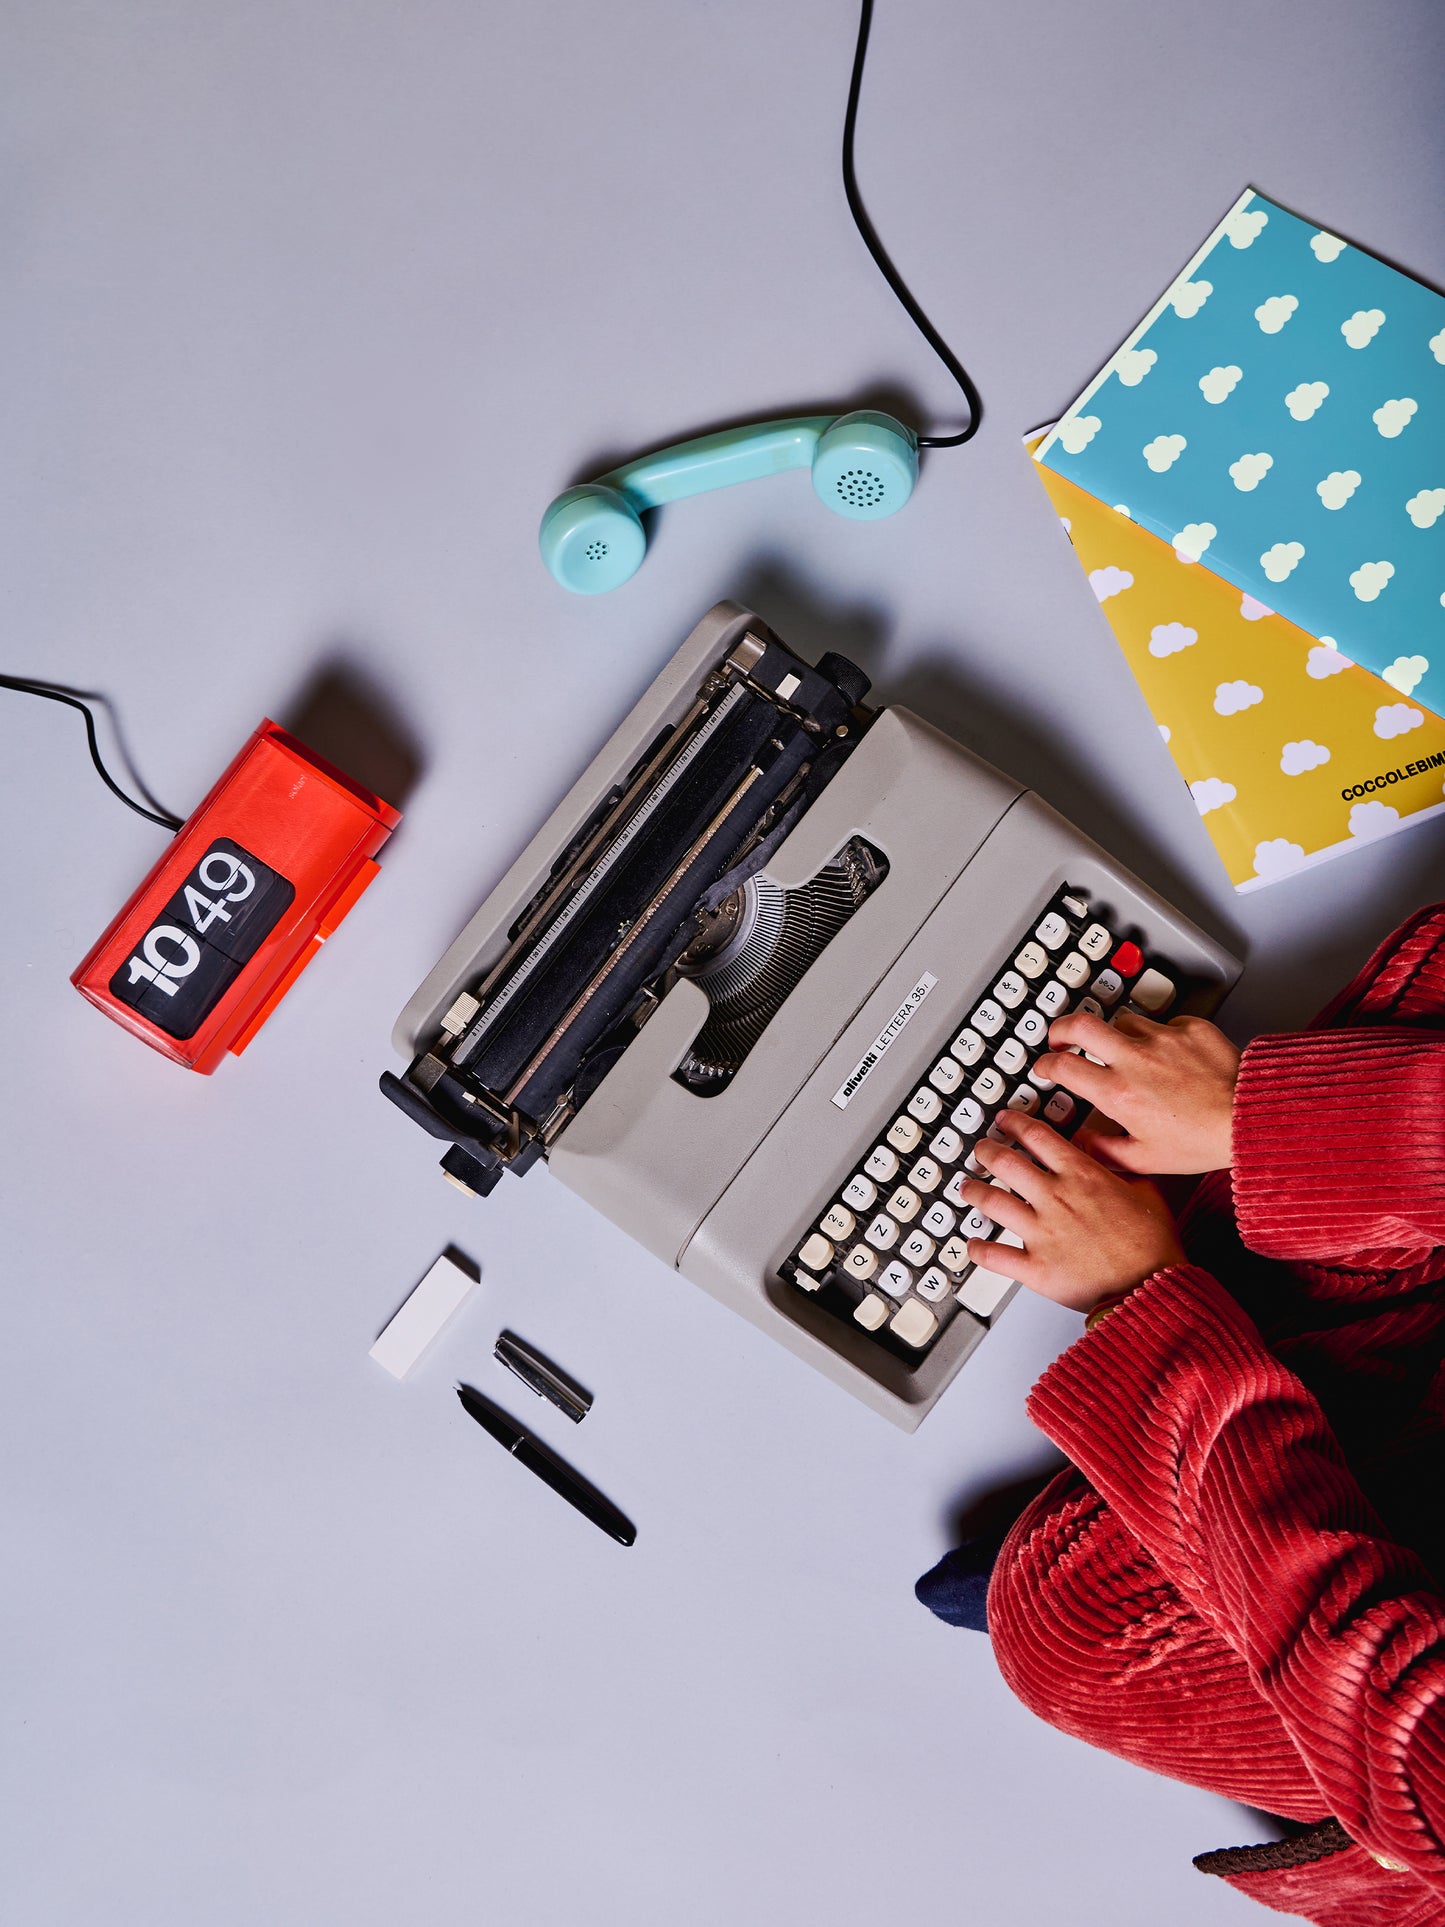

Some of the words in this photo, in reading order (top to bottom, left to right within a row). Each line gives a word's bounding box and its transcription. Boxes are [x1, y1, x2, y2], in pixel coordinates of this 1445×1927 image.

[1341, 750, 1445, 801] COCCOLEBIM
[1045, 991, 1055, 1003] P
[979, 1009, 988, 1017] 9
[1024, 1020, 1037, 1031] O
[959, 1038, 968, 1046] 8
[843, 1052, 878, 1097] olivetti
[875, 1003, 915, 1051] LETTERA
[936, 1066, 945, 1075] 7
[980, 1077, 994, 1090] U
[916, 1096, 924, 1104] 6
[1019, 1094, 1030, 1106] J
[959, 1107, 972, 1118] Y
[894, 1126, 904, 1134] 5
[938, 1137, 950, 1147] T
[873, 1156, 881, 1164] 4
[917, 1167, 931, 1180] R
[850, 1184, 860, 1193] 3
[895, 1196, 910, 1209] E
[827, 1214, 838, 1223] 2
[931, 1212, 944, 1225] D
[970, 1217, 983, 1229] C
[874, 1224, 888, 1237] Z
[910, 1241, 923, 1253] S
[947, 1246, 961, 1259] X
[853, 1254, 868, 1266] Q
[889, 1273, 902, 1284] A
[924, 1275, 939, 1290] W
